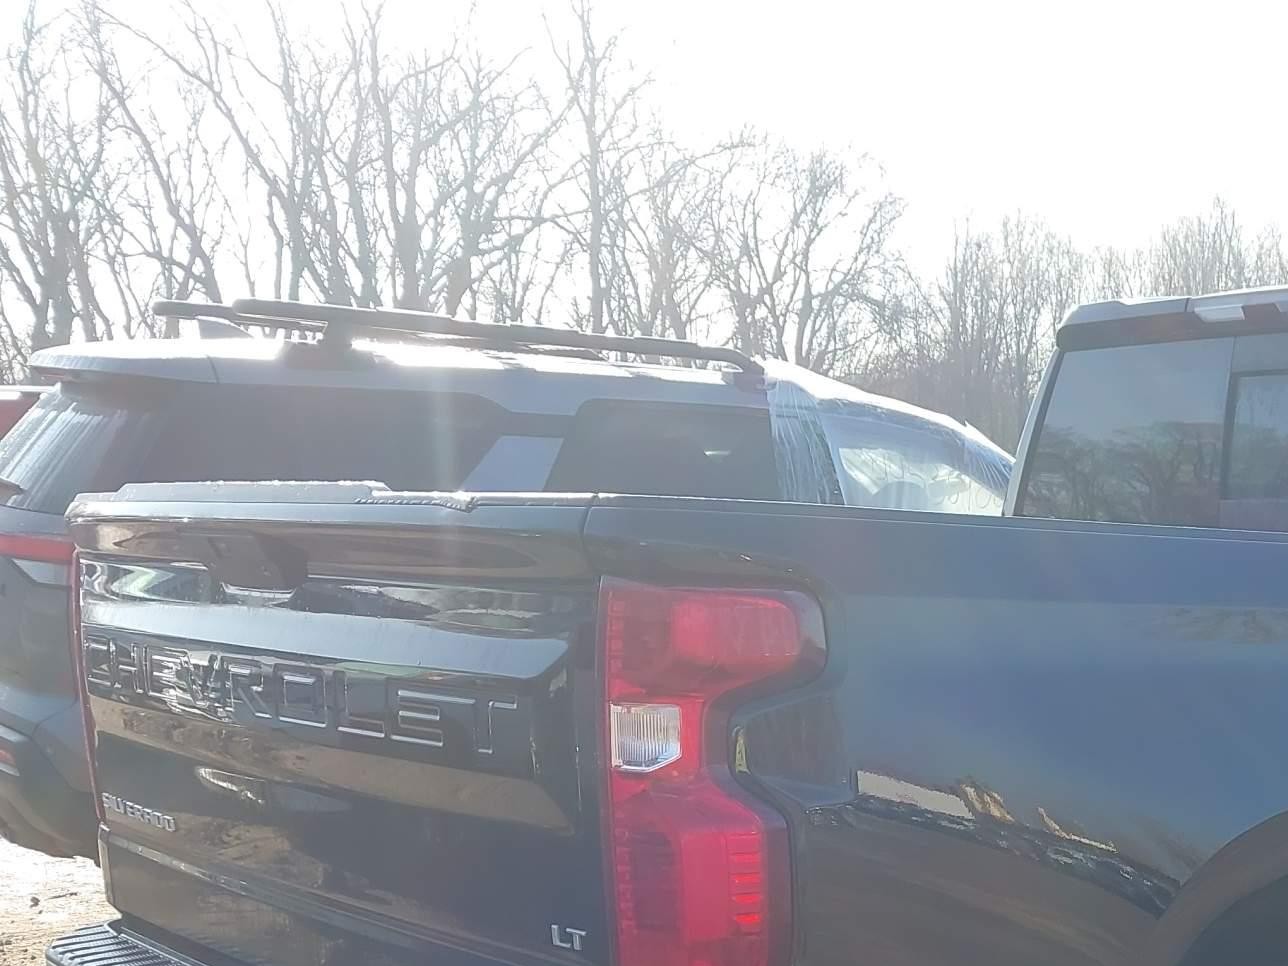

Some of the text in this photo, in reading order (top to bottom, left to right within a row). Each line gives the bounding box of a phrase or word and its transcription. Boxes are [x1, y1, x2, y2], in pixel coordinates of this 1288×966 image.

[83, 634, 518, 755] CHEVROLET
[102, 792, 176, 832] SILVERADO
[551, 924, 587, 950] LT
